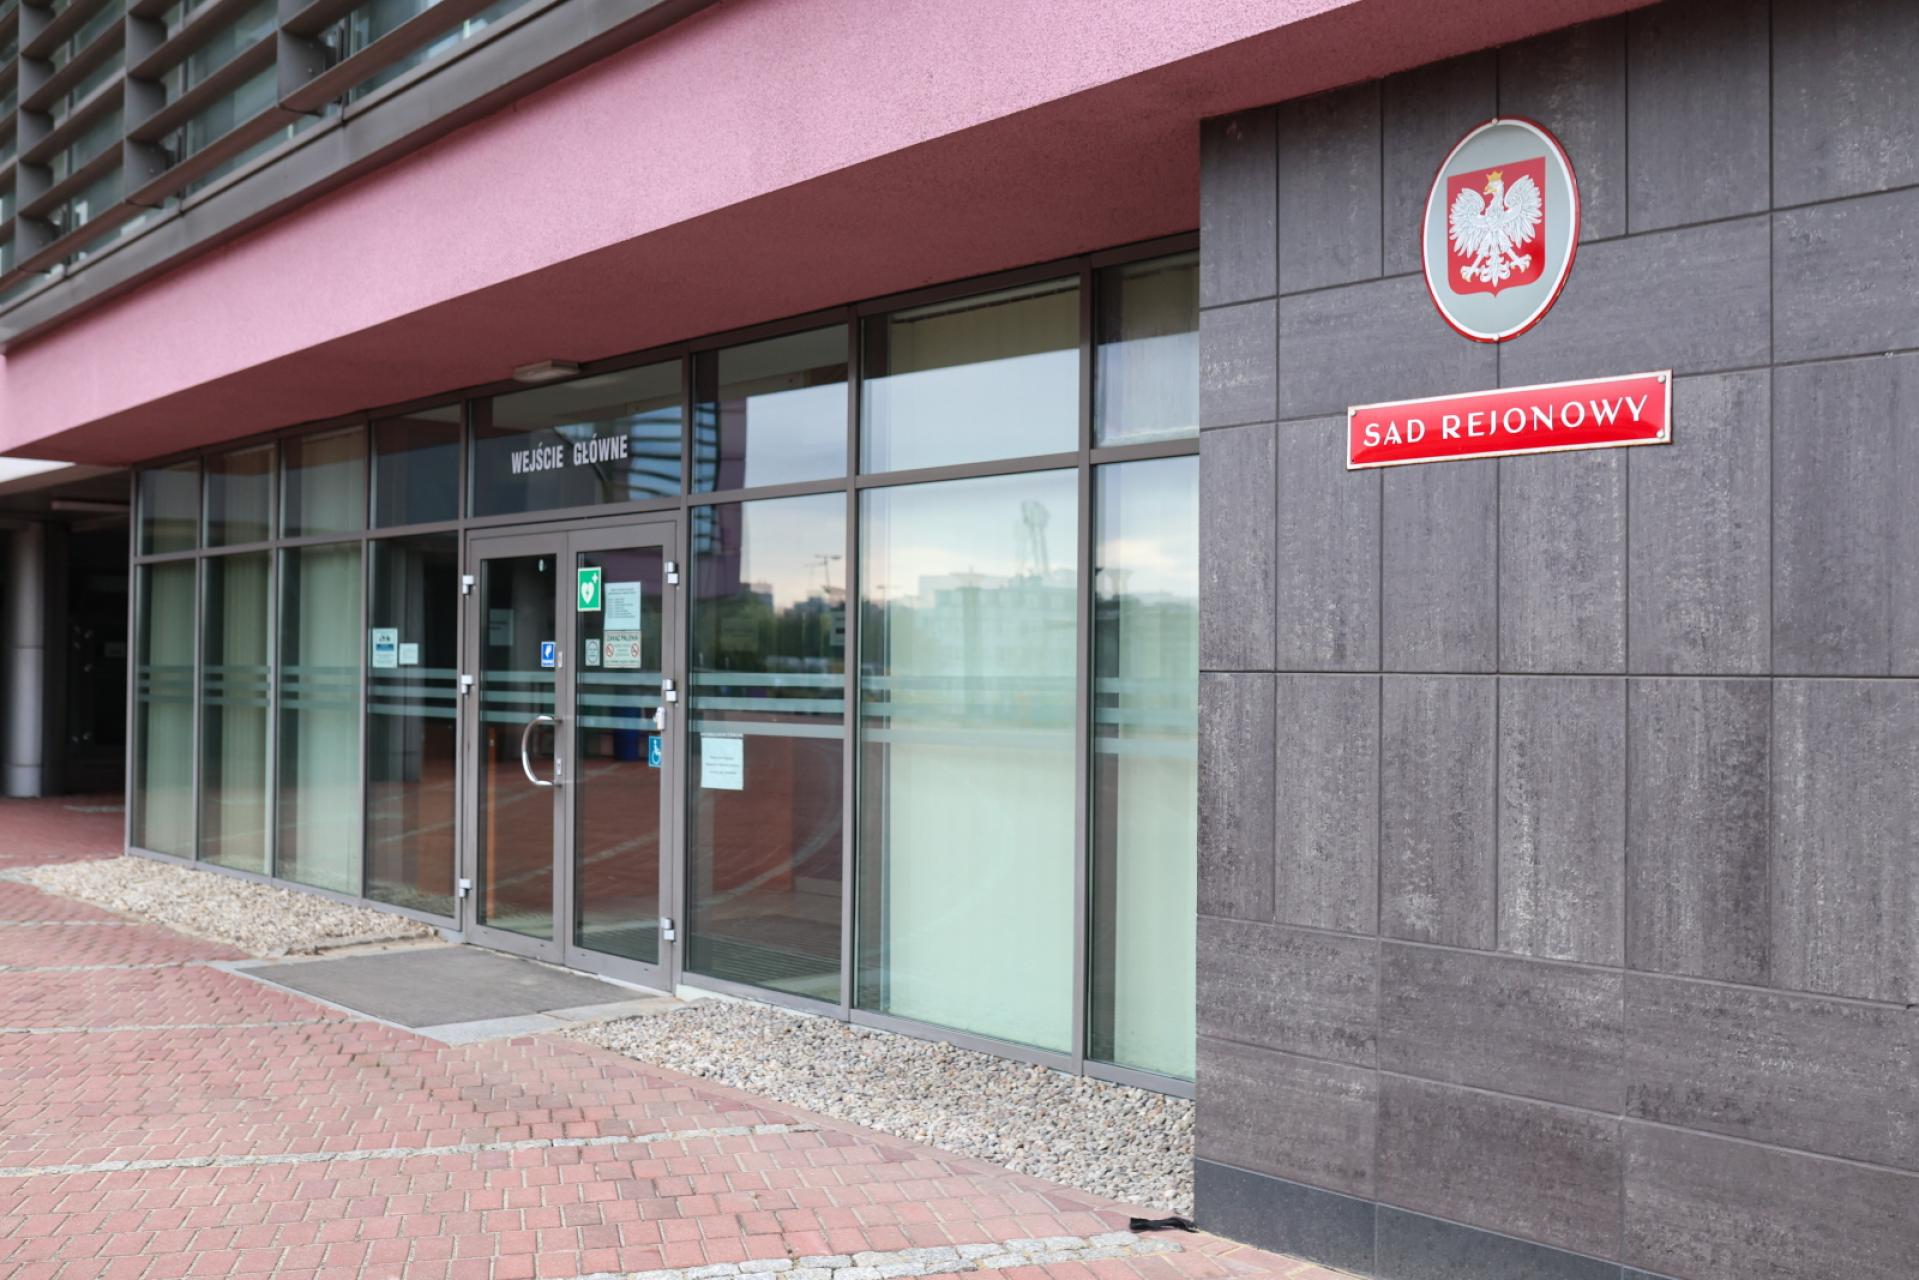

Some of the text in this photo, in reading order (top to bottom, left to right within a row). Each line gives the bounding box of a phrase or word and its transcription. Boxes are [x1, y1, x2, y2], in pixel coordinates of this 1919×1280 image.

[1442, 395, 1648, 439] REJONOWY
[511, 433, 628, 474] WEJŚCIE GŁÓWNE
